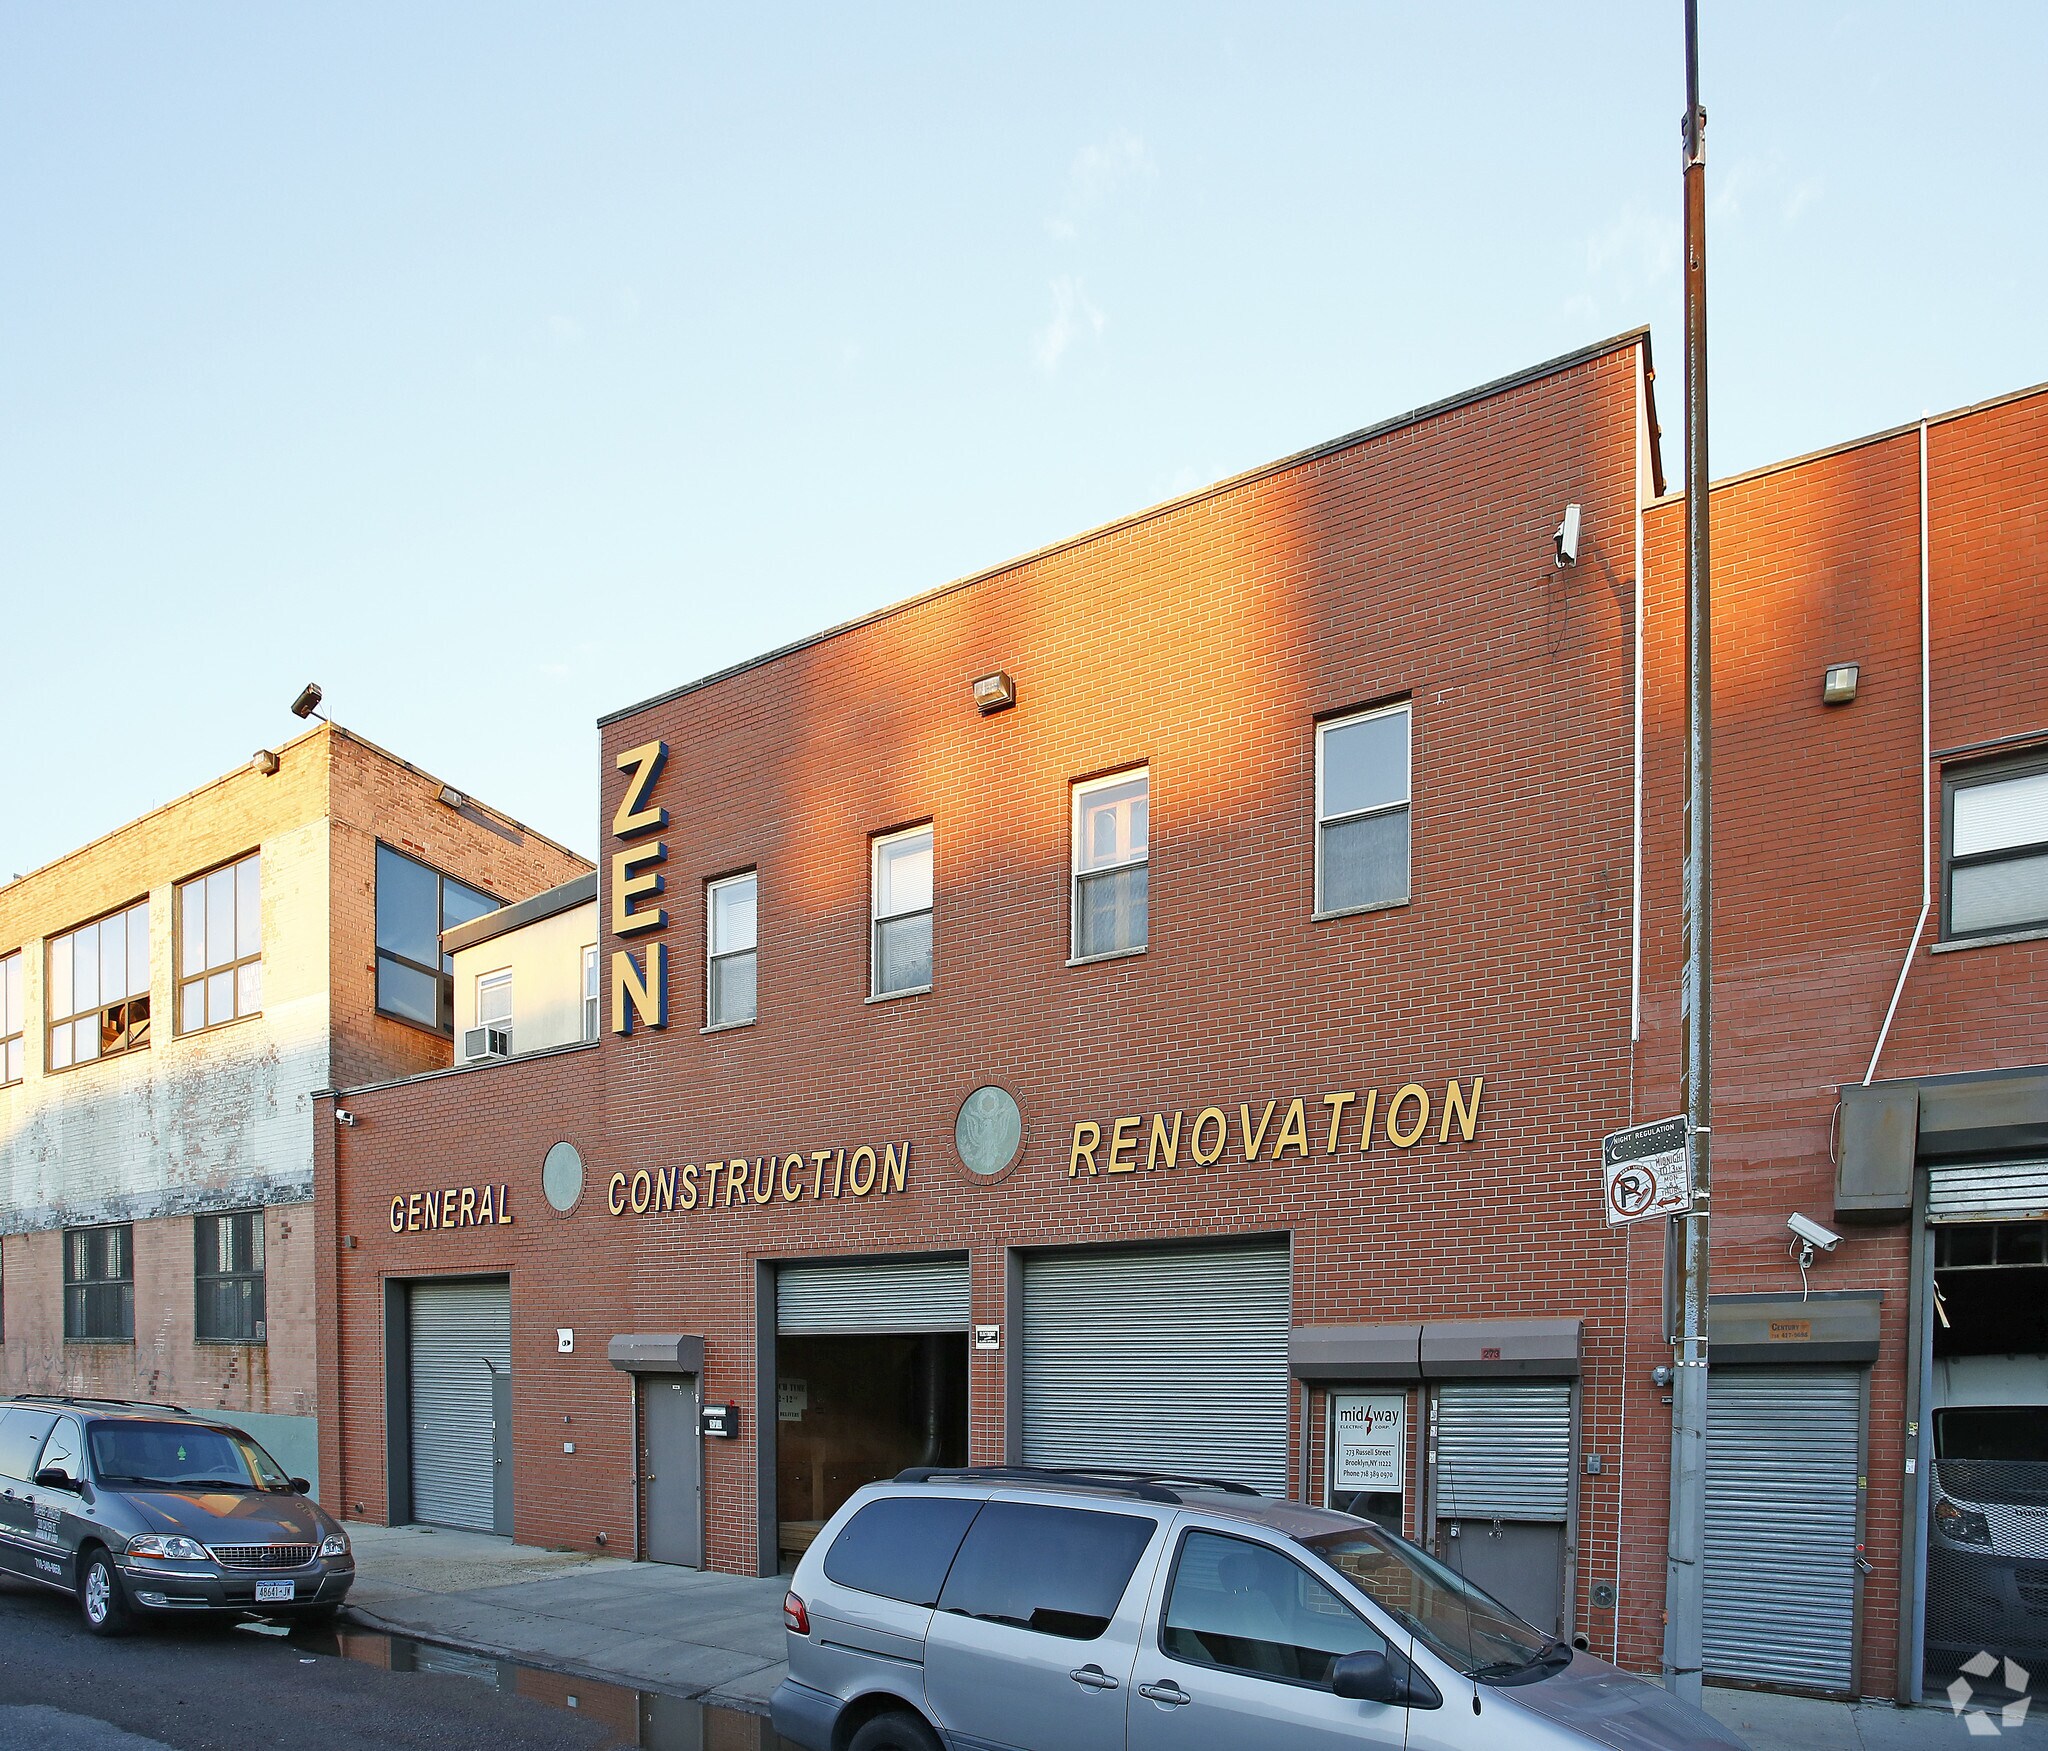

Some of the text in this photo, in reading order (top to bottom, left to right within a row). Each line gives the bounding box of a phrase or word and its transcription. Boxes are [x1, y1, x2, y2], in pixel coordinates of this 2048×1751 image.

[611, 739, 669, 1037] ZEN
[1613, 1123, 1675, 1144] NIGHT REGULATION
[389, 1076, 1485, 1233] GENERAL CONSTRUCTION RENOVATION
[1663, 1174, 1678, 1182] MON
[1483, 1349, 1500, 1359] 273
[1345, 1448, 1392, 1457] 273 Russell Street
[1360, 1470, 1369, 1478] 718
[1370, 1470, 1379, 1479] 389
[1380, 1471, 1394, 1479] 0970
